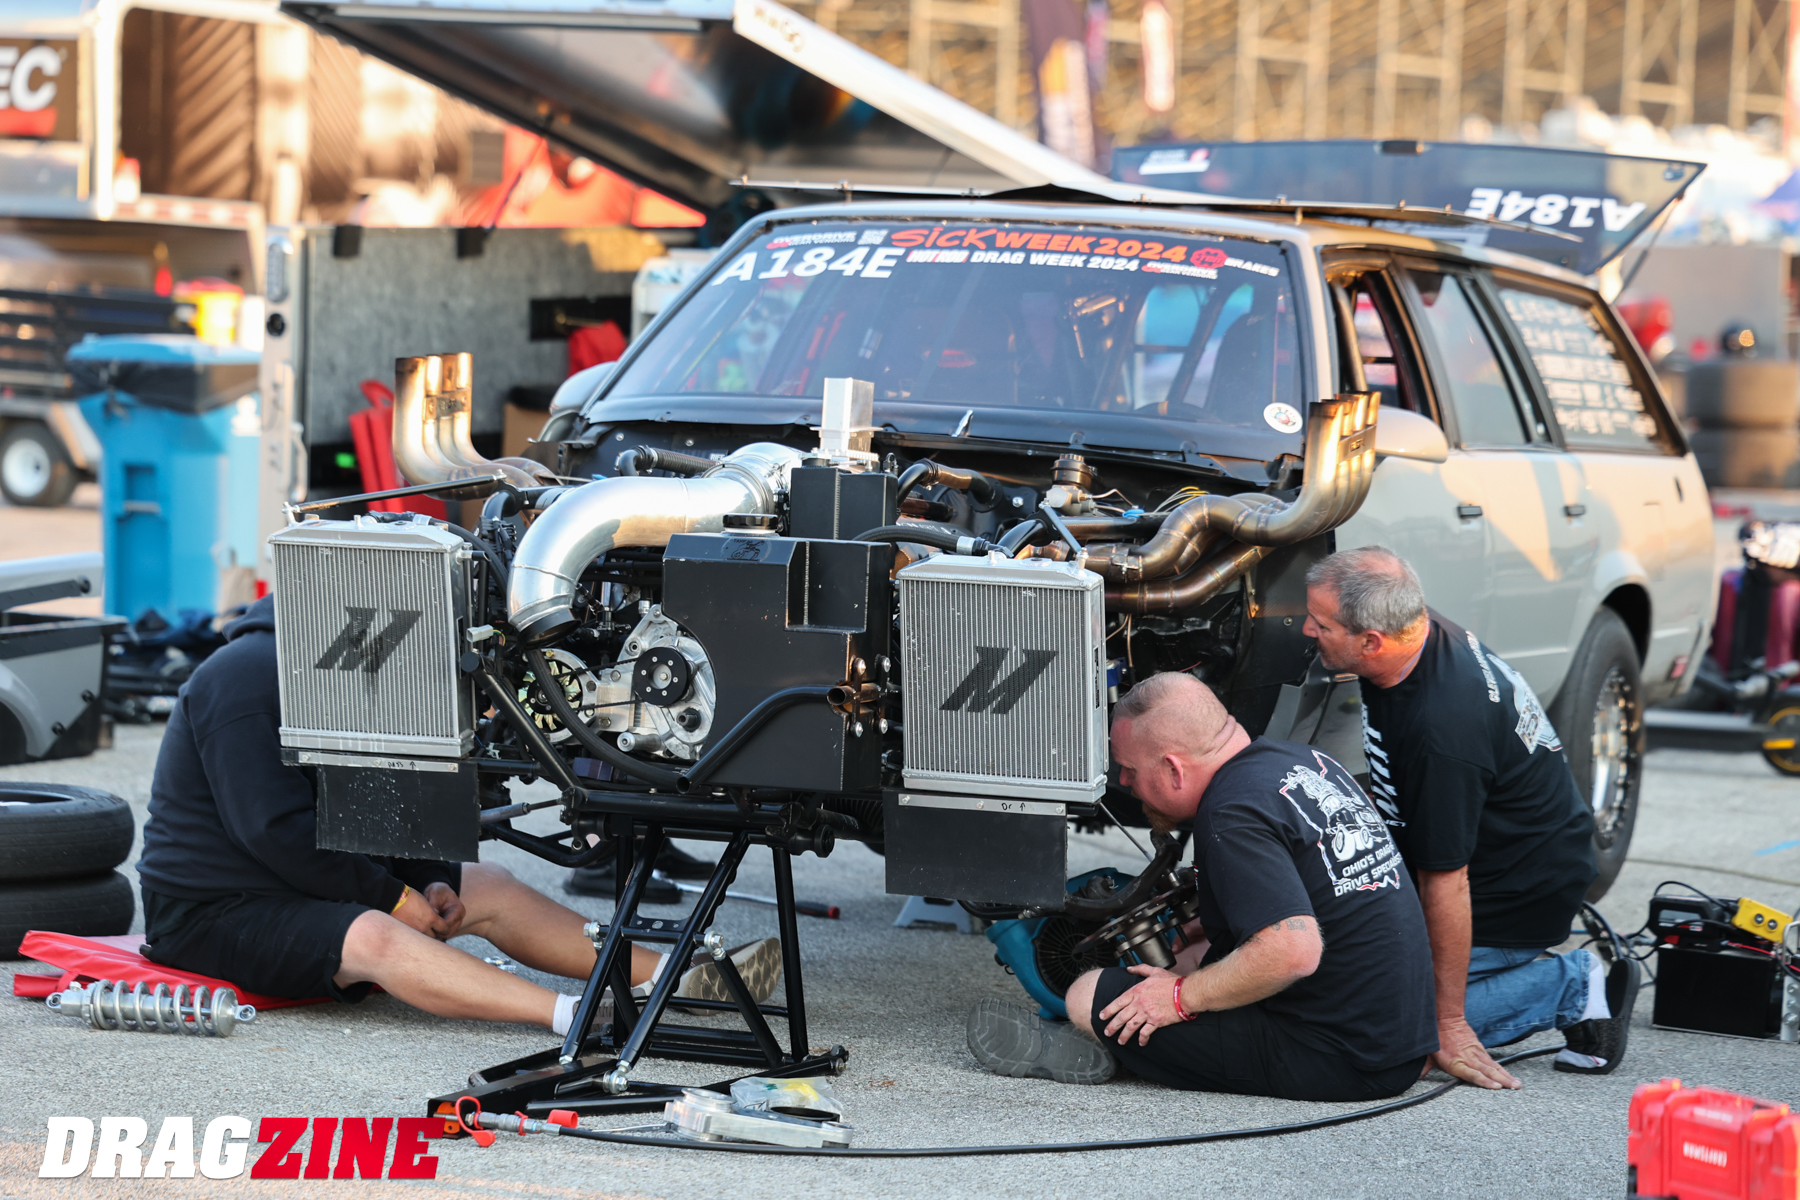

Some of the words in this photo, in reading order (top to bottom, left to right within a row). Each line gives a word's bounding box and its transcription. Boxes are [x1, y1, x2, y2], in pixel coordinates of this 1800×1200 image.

[1464, 187, 1647, 231] A184E
[995, 231, 1097, 255] WEEK
[1094, 237, 1188, 262] 2024
[711, 246, 906, 286] A184E
[970, 250, 1026, 265] DRAG
[1029, 252, 1089, 268] WEEK
[1090, 255, 1140, 272] 2024
[1224, 257, 1279, 277] BRAKES
[1342, 853, 1376, 877] OHIO'S
[1334, 873, 1370, 897] DRIVE
